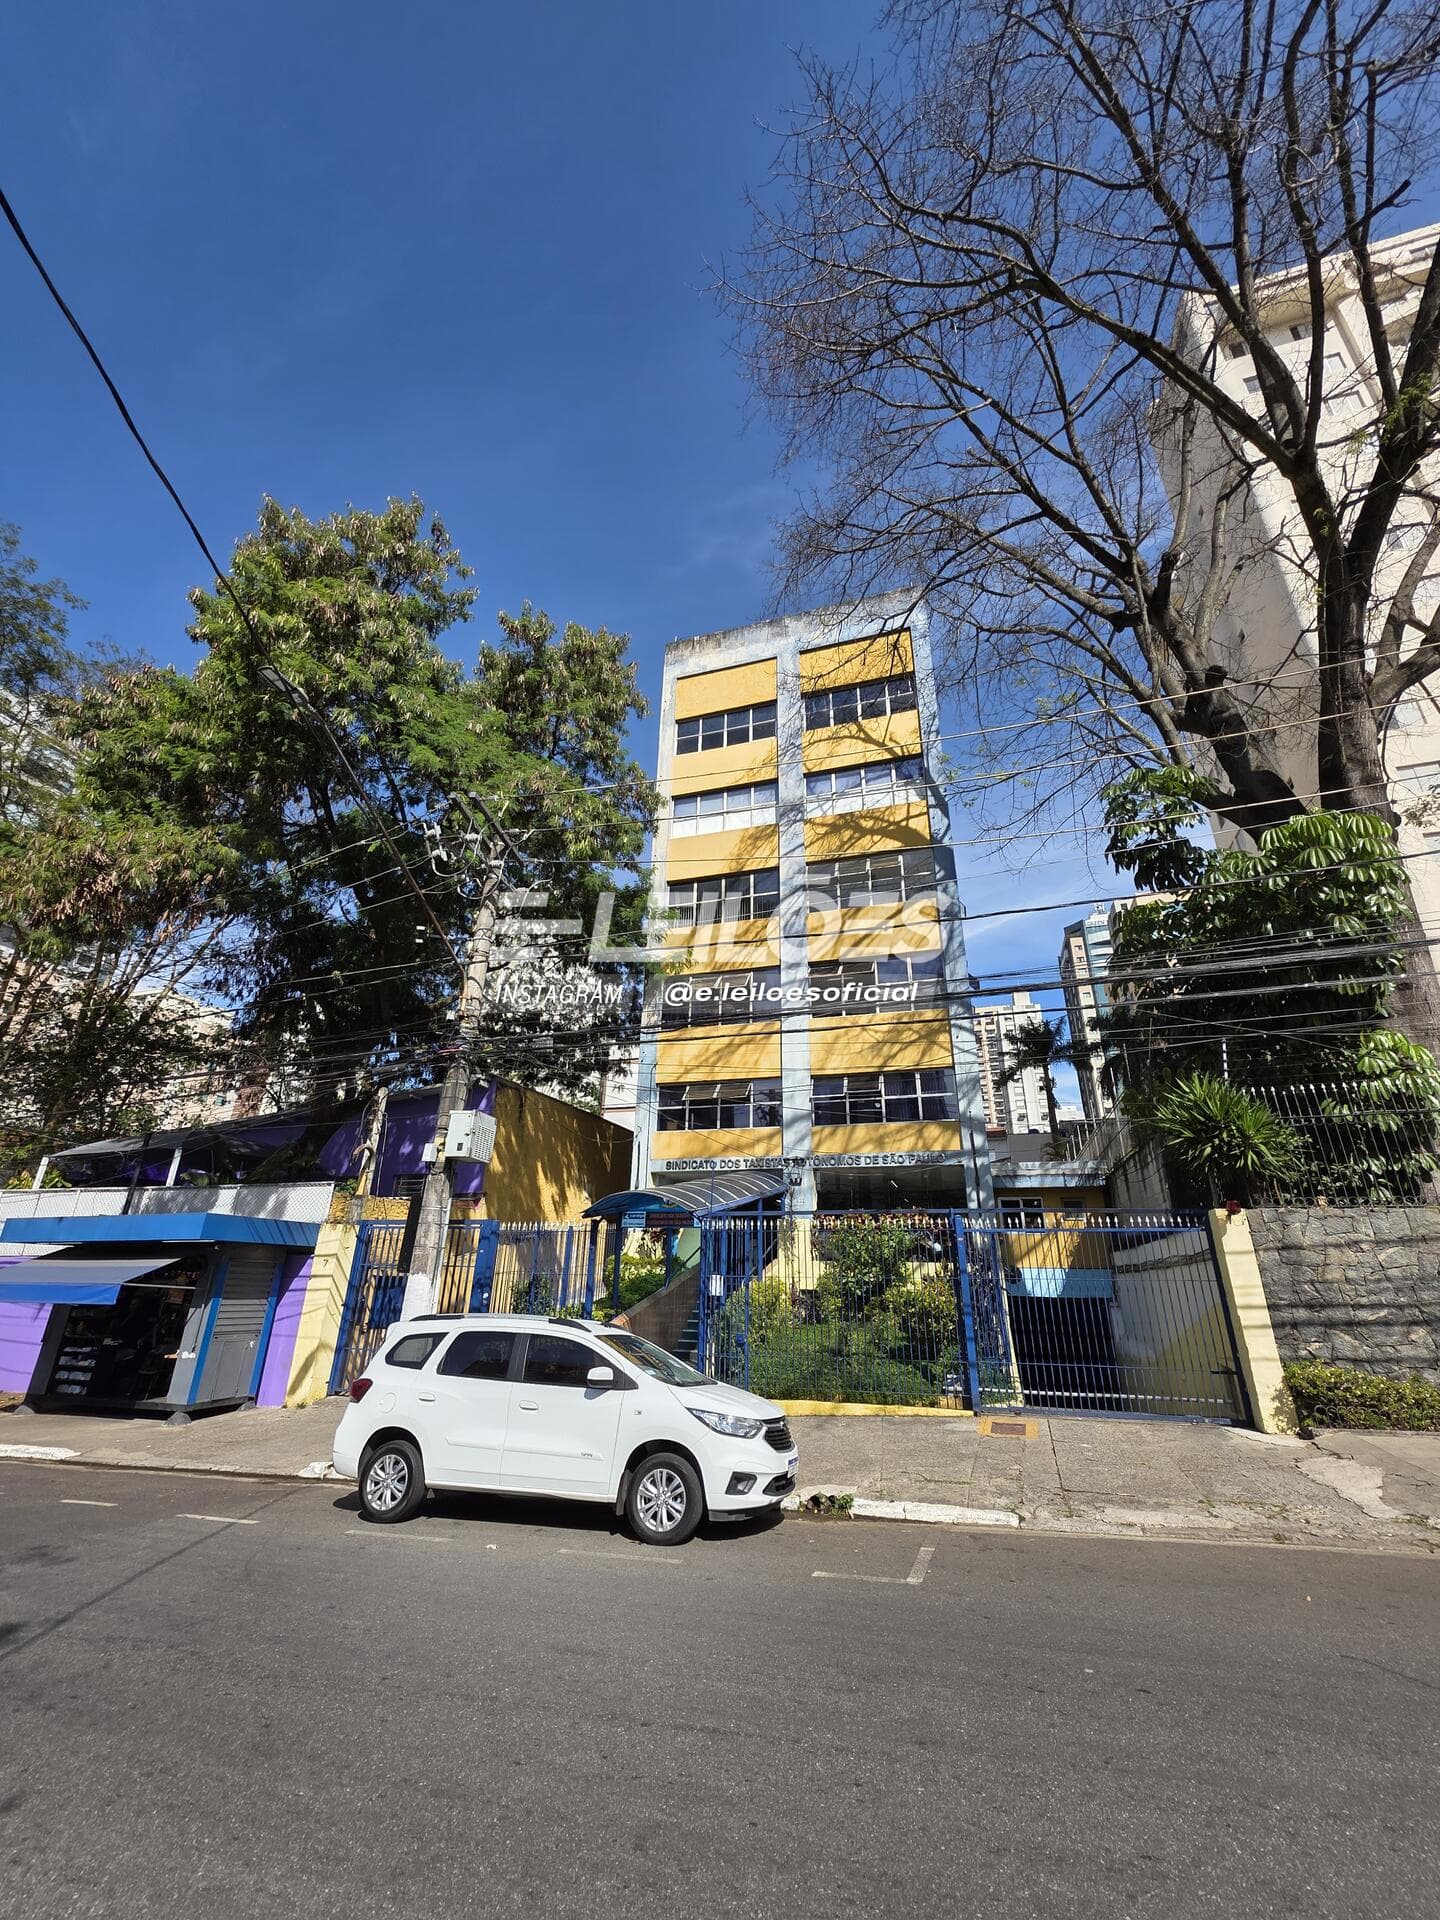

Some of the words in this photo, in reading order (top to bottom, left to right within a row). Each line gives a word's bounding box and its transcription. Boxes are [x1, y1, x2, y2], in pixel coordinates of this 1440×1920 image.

[665, 1160, 717, 1171] SINDICATO
[719, 1159, 743, 1169] DOS
[743, 1157, 790, 1169] TAXISTAS
[864, 1155, 879, 1166] DE
[882, 1153, 905, 1165] SÃO
[908, 1152, 946, 1164] PAULO
